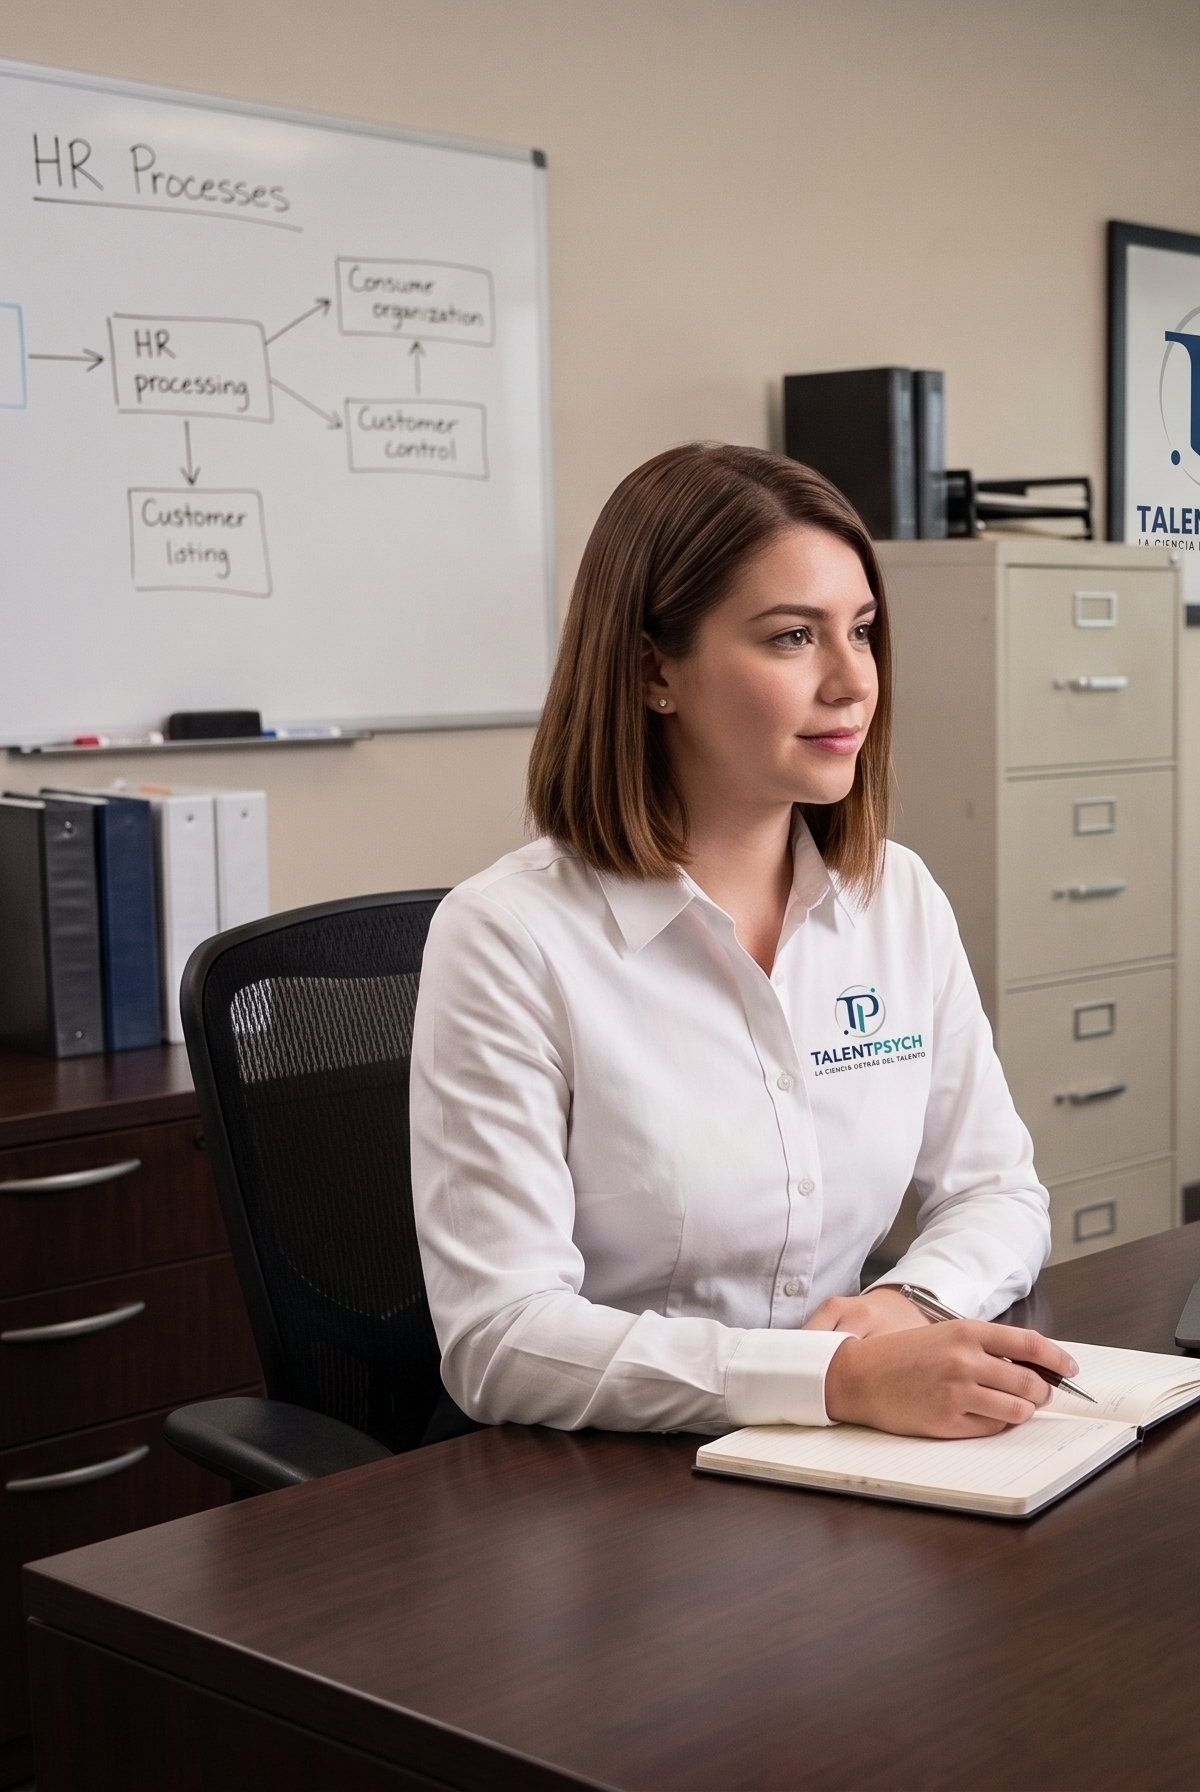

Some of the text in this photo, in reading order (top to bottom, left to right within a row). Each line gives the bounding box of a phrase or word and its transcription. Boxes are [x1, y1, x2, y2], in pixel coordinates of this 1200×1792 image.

[33, 133, 291, 213] HR Processes
[134, 328, 177, 360] HR
[134, 373, 251, 413] processing
[357, 405, 460, 434] Customer
[384, 438, 456, 461] control
[141, 497, 248, 529] Customer
[810, 1034, 923, 1066] TALENTPSYCH
[896, 1051, 926, 1063] TALENTO
